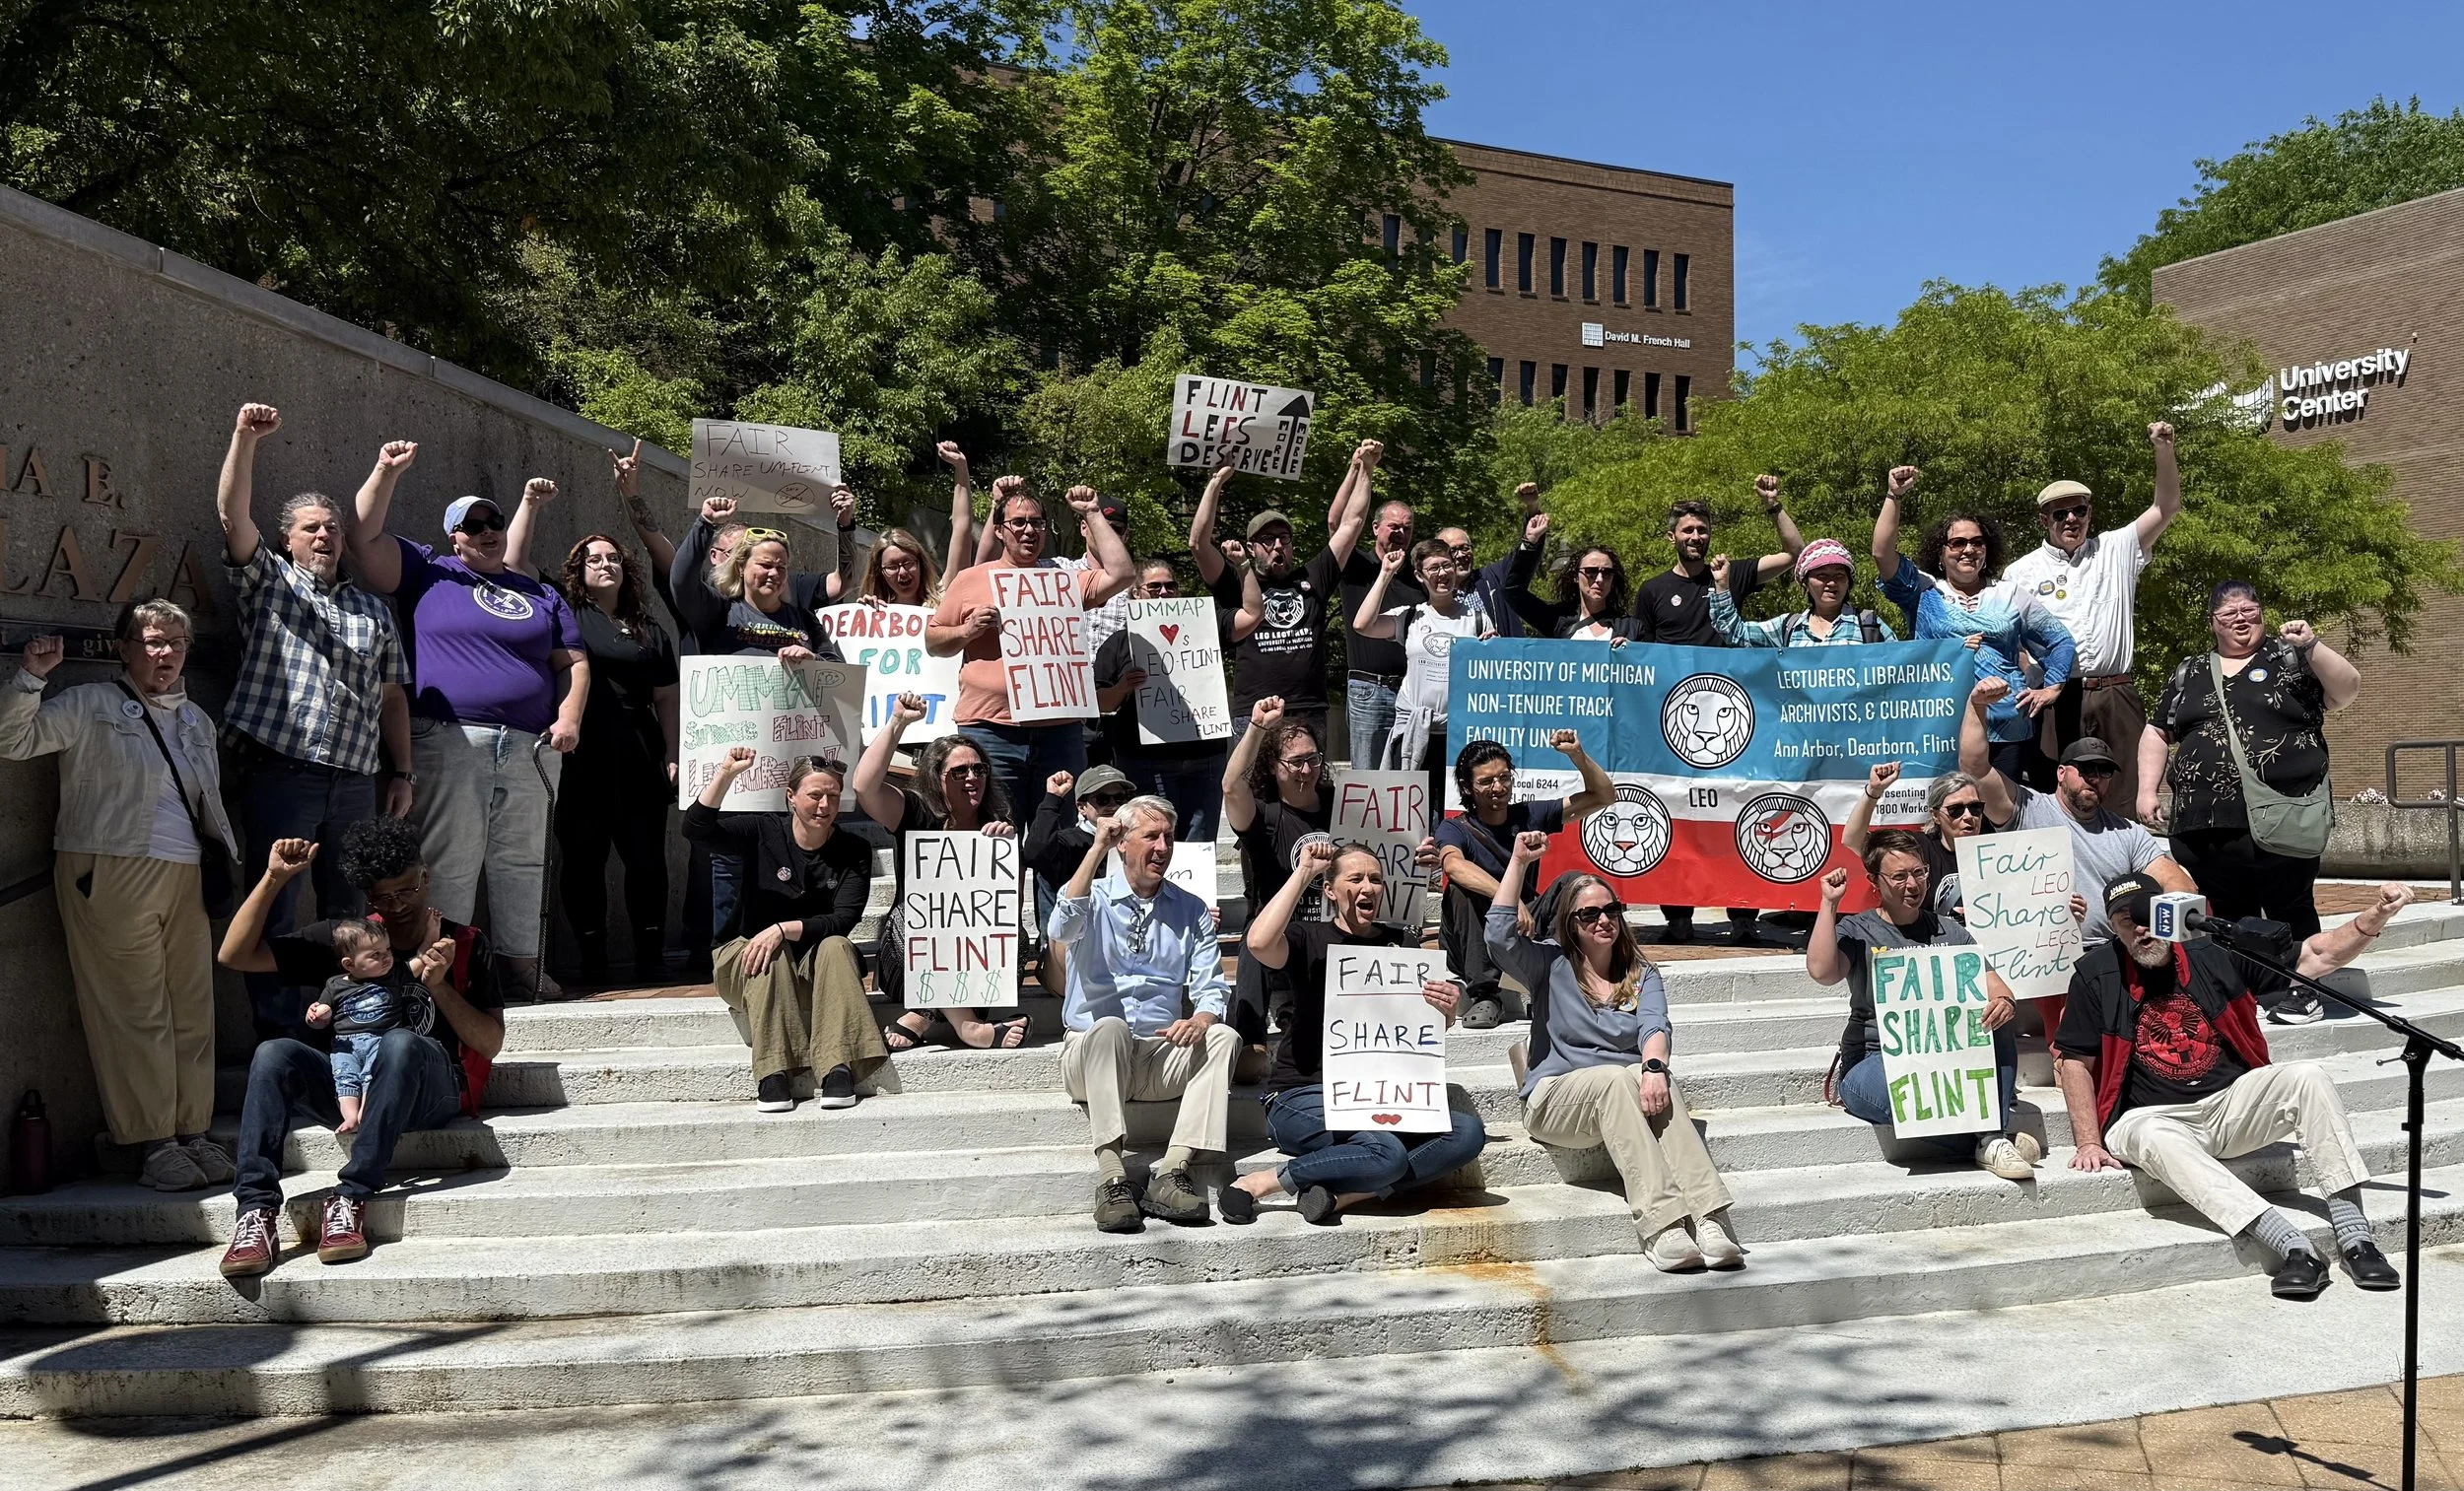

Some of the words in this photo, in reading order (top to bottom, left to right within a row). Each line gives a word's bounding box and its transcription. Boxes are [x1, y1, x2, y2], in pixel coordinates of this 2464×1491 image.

[1605, 330, 1629, 342] David
[1631, 333, 1642, 344] M.
[1643, 335, 1673, 347] French
[1674, 338, 1690, 349] Hall
[2281, 348, 2410, 391] University
[1186, 380, 1268, 413] FLINT
[2282, 388, 2368, 421] Center
[706, 424, 793, 456] FAIR
[1271, 420, 1290, 470] MORE
[1289, 422, 1307, 473] MORE
[693, 461, 754, 479] SHARE
[1180, 441, 1272, 472] DESERVE
[694, 485, 750, 499] NOW
[993, 571, 1076, 608] FAIR
[822, 609, 934, 638] DEARBO
[1128, 598, 1205, 621] UMMAP
[1000, 616, 1085, 658] SHARE
[859, 648, 923, 674] FOR
[1468, 659, 1554, 681] UNIVERSITY
[1558, 662, 1577, 682] OF
[1582, 663, 1656, 686] MICHIGAN
[1777, 667, 1860, 689] LECTURERS,
[1864, 662, 1954, 687] LIBRARIANS,
[690, 665, 846, 717] UMMAP
[1007, 661, 1089, 711] FLINT
[1140, 685, 1191, 708] FAIR
[1171, 707, 1217, 725] SHARE
[1467, 693, 1563, 715] NON-TENURE
[1568, 695, 1613, 717] TRACK
[1780, 703, 1862, 724] ARCHIVISTS,
[1865, 703, 1876, 720] &
[1880, 698, 1955, 720] CURATORS
[1196, 722, 1229, 737] FLINT
[1466, 726, 1526, 747] FACULTY
[1774, 738, 1799, 758] Ann
[1802, 738, 1844, 759] Arbor,
[1848, 736, 1920, 758] Dearborn,
[1923, 734, 1956, 754] Flint
[1512, 778, 1534, 788] Local
[1537, 779, 1558, 789] 6244
[1689, 787, 1718, 808] LEO
[1338, 783, 1426, 833] FAIR
[915, 837, 1015, 880] FAIR
[1977, 844, 2058, 879] Fair
[2031, 871, 2070, 896] LEO
[907, 889, 1017, 930] SHARE
[1970, 892, 2069, 929] Share
[908, 933, 1017, 972] FLINT
[2035, 928, 2080, 948] LECS
[1338, 957, 1430, 990] FAIR
[1875, 952, 1987, 1004] FAIR
[1989, 945, 2070, 981] Flint
[1330, 1019, 1442, 1050] SHARE
[1882, 1005, 1992, 1056] SHARE
[1333, 1080, 1440, 1106] FLINT
[1889, 1067, 1995, 1123] FLINT
